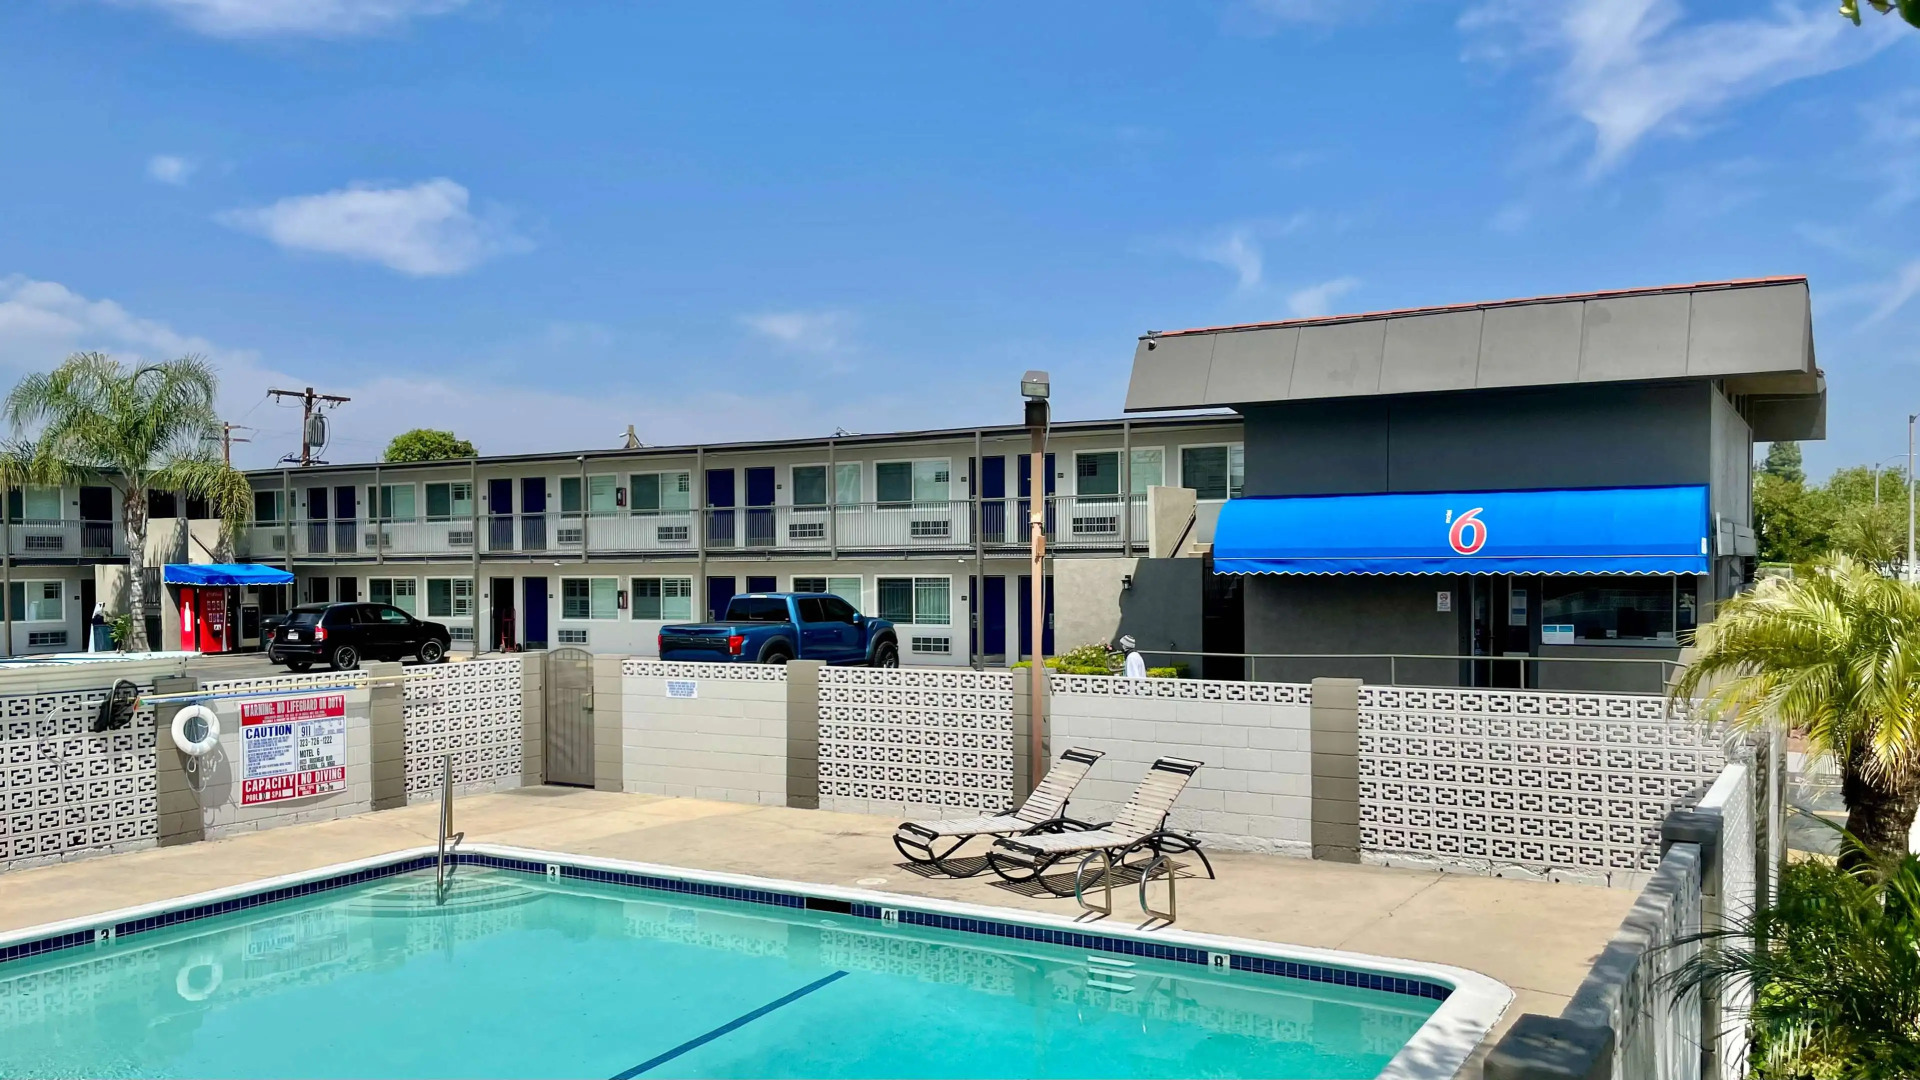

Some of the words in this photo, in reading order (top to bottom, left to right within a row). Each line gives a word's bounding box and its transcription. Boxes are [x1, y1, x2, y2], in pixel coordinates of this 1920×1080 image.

[1449, 507, 1487, 555] 6
[243, 703, 275, 718] WARNING:
[277, 702, 286, 714] NO
[287, 698, 318, 713] LIFEGUARD
[318, 697, 327, 710] ON
[327, 695, 343, 709] DUTY
[245, 724, 292, 739] CAUTION
[301, 725, 311, 737] 911
[299, 749, 314, 758] MOTEL
[316, 748, 320, 756] 6
[245, 774, 295, 793] CAPACITY
[301, 772, 312, 785] NO
[315, 768, 342, 782] DIVING
[245, 794, 259, 803] POOL
[271, 791, 282, 799] SPA
